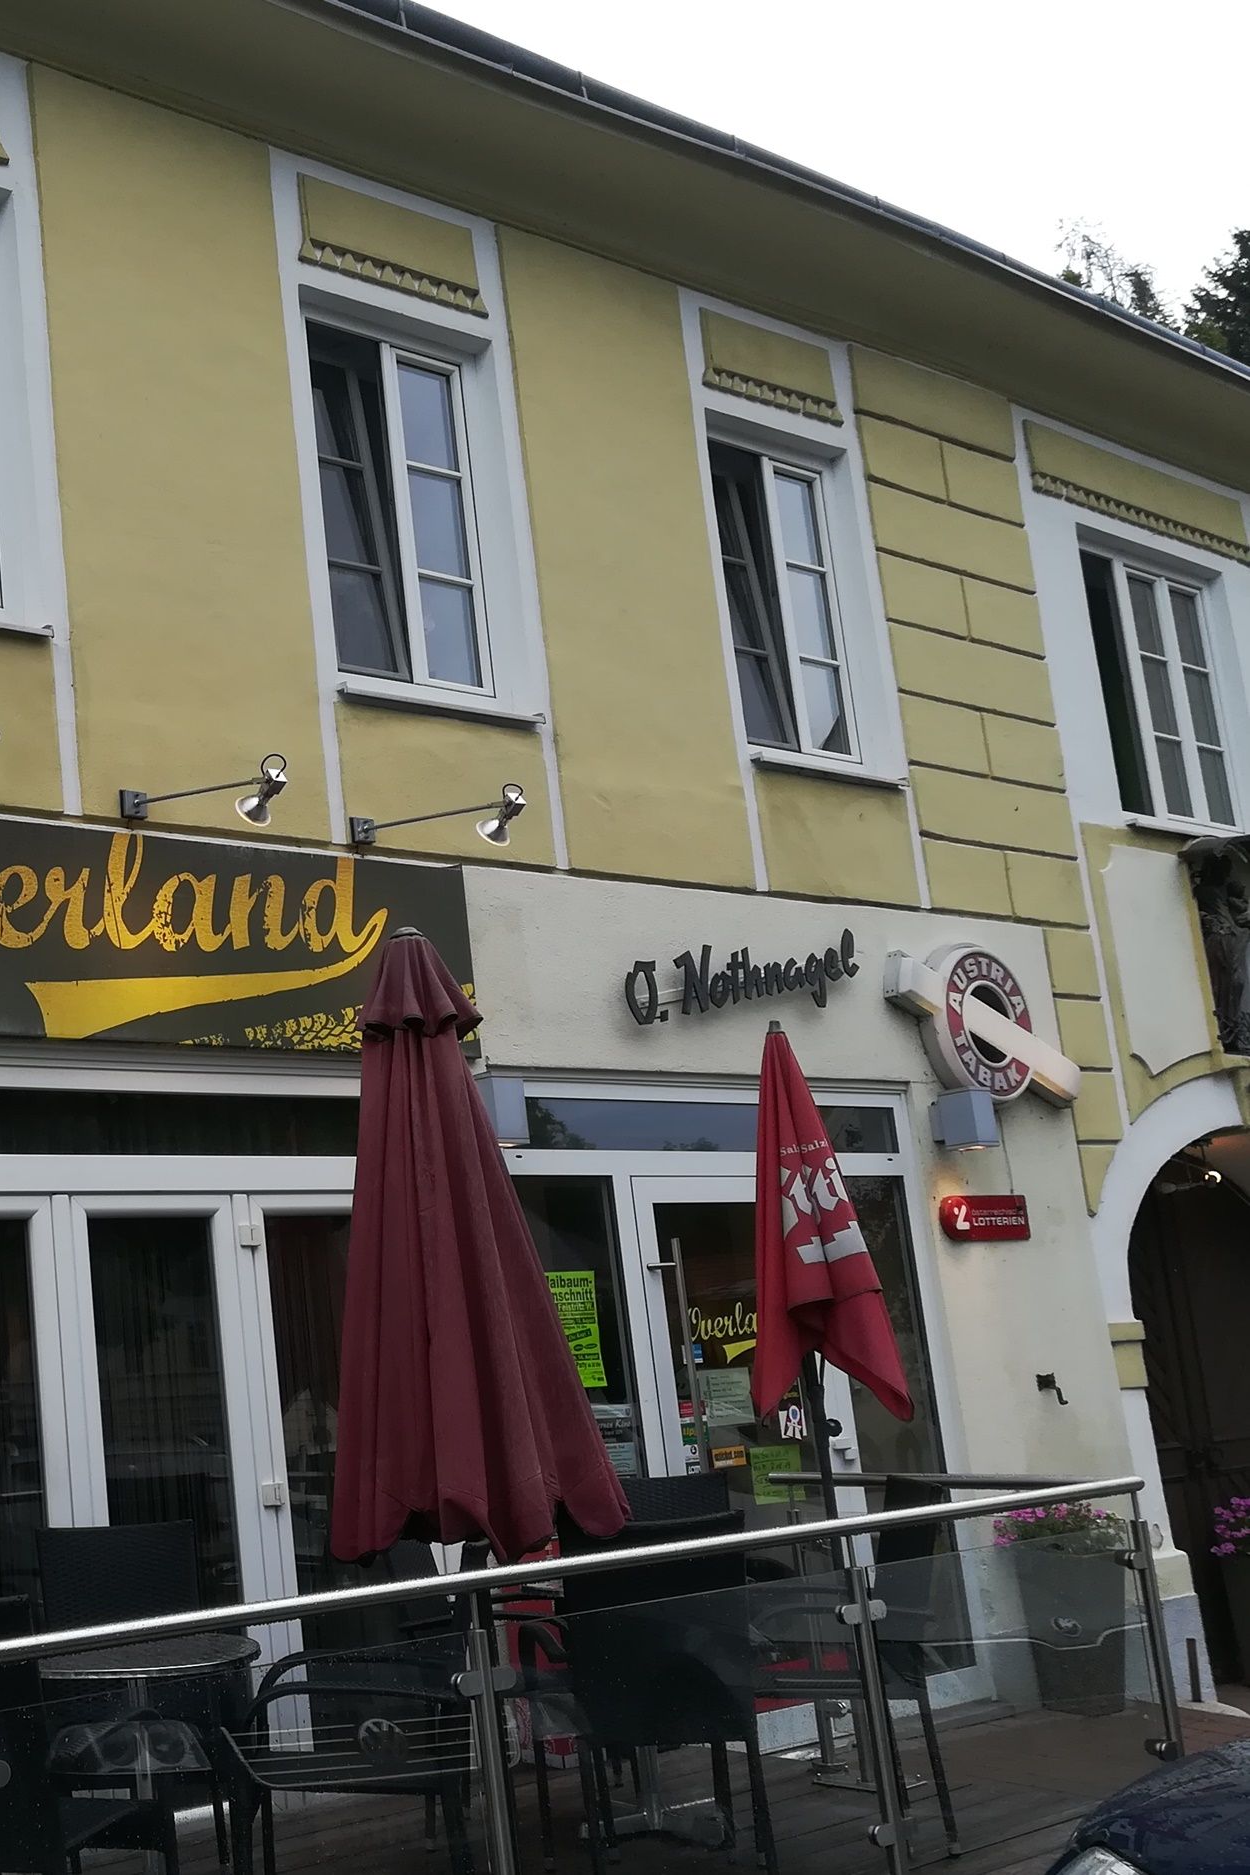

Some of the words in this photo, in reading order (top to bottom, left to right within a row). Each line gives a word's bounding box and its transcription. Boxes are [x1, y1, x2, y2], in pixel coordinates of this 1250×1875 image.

[673, 928, 860, 1015] Nothnagel
[948, 956, 1026, 1015] AUSTRIA
[954, 1030, 1023, 1091] TABAK
[972, 1216, 1025, 1227] LOTTERIEN
